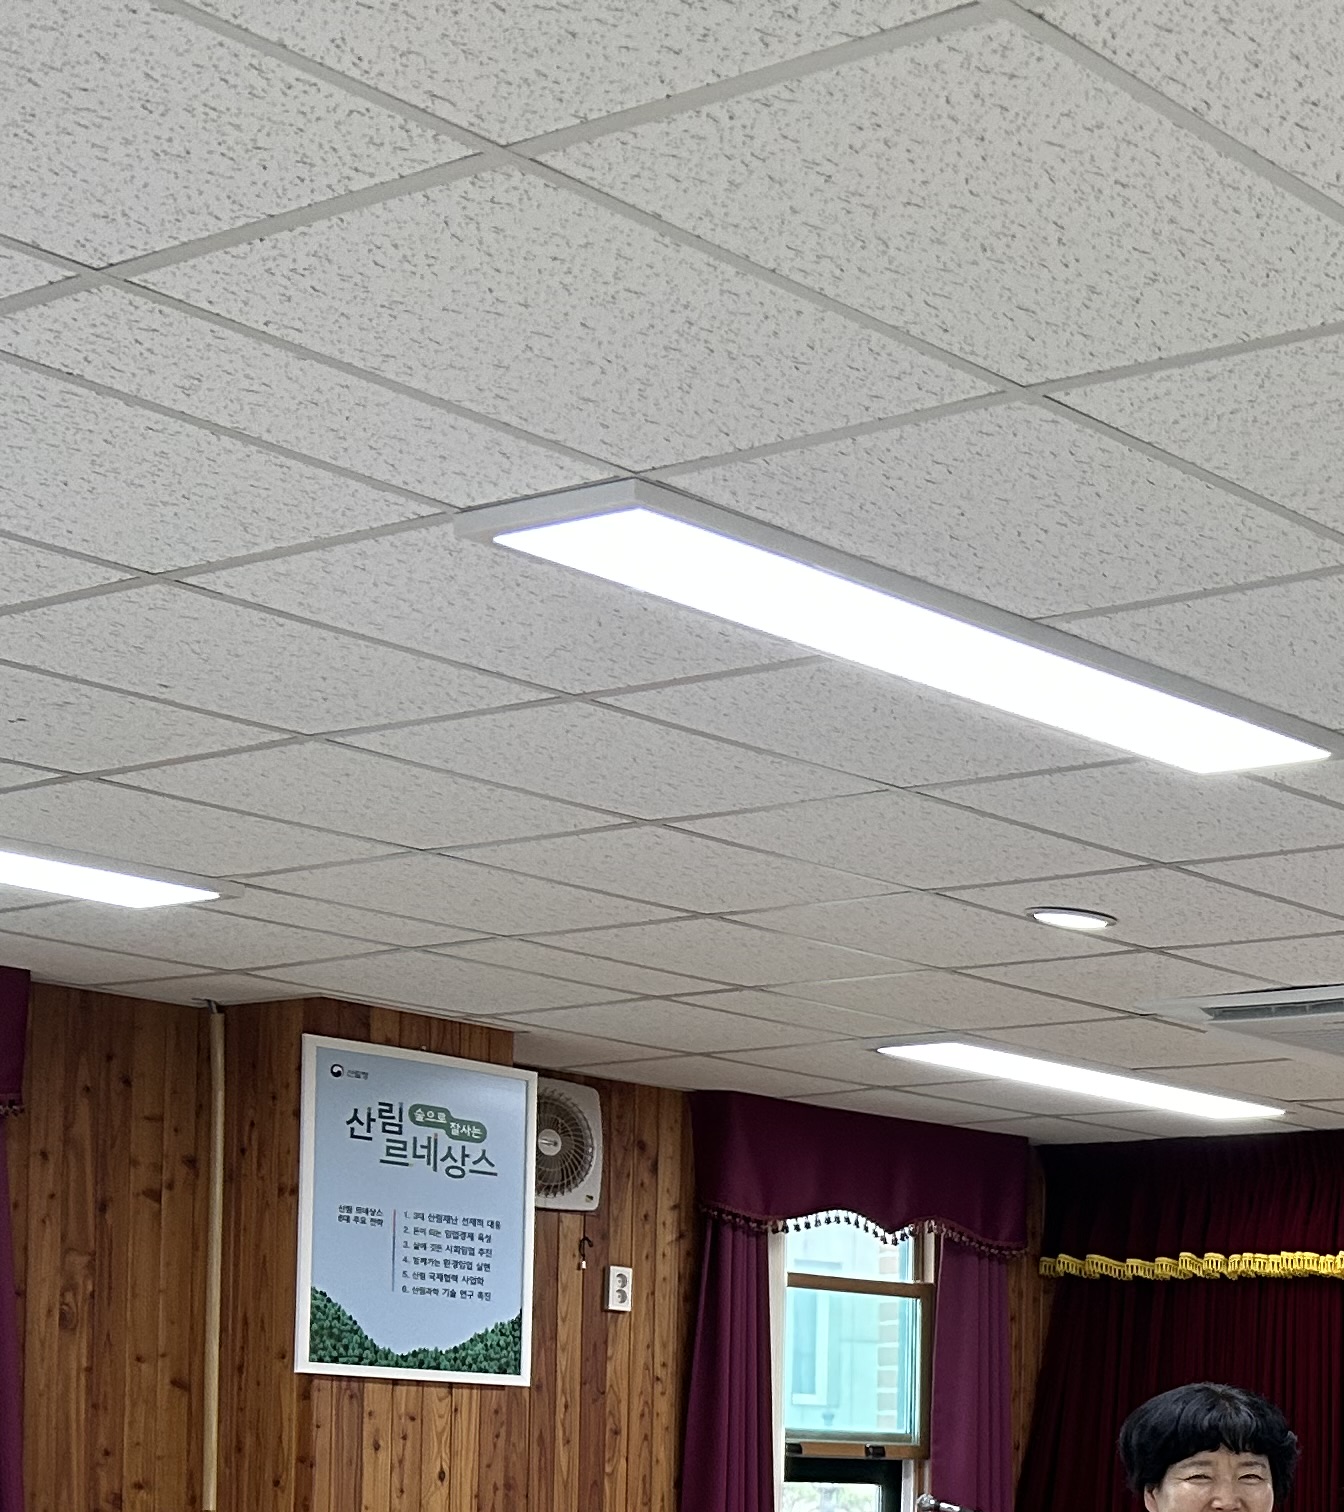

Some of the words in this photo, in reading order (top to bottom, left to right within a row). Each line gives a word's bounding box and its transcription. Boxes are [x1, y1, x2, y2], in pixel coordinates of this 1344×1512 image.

[346, 1102, 404, 1141] 산림
[414, 1108, 447, 1124] 숲으로
[450, 1122, 483, 1139] 잘사는
[380, 1134, 498, 1179] 르네상스
